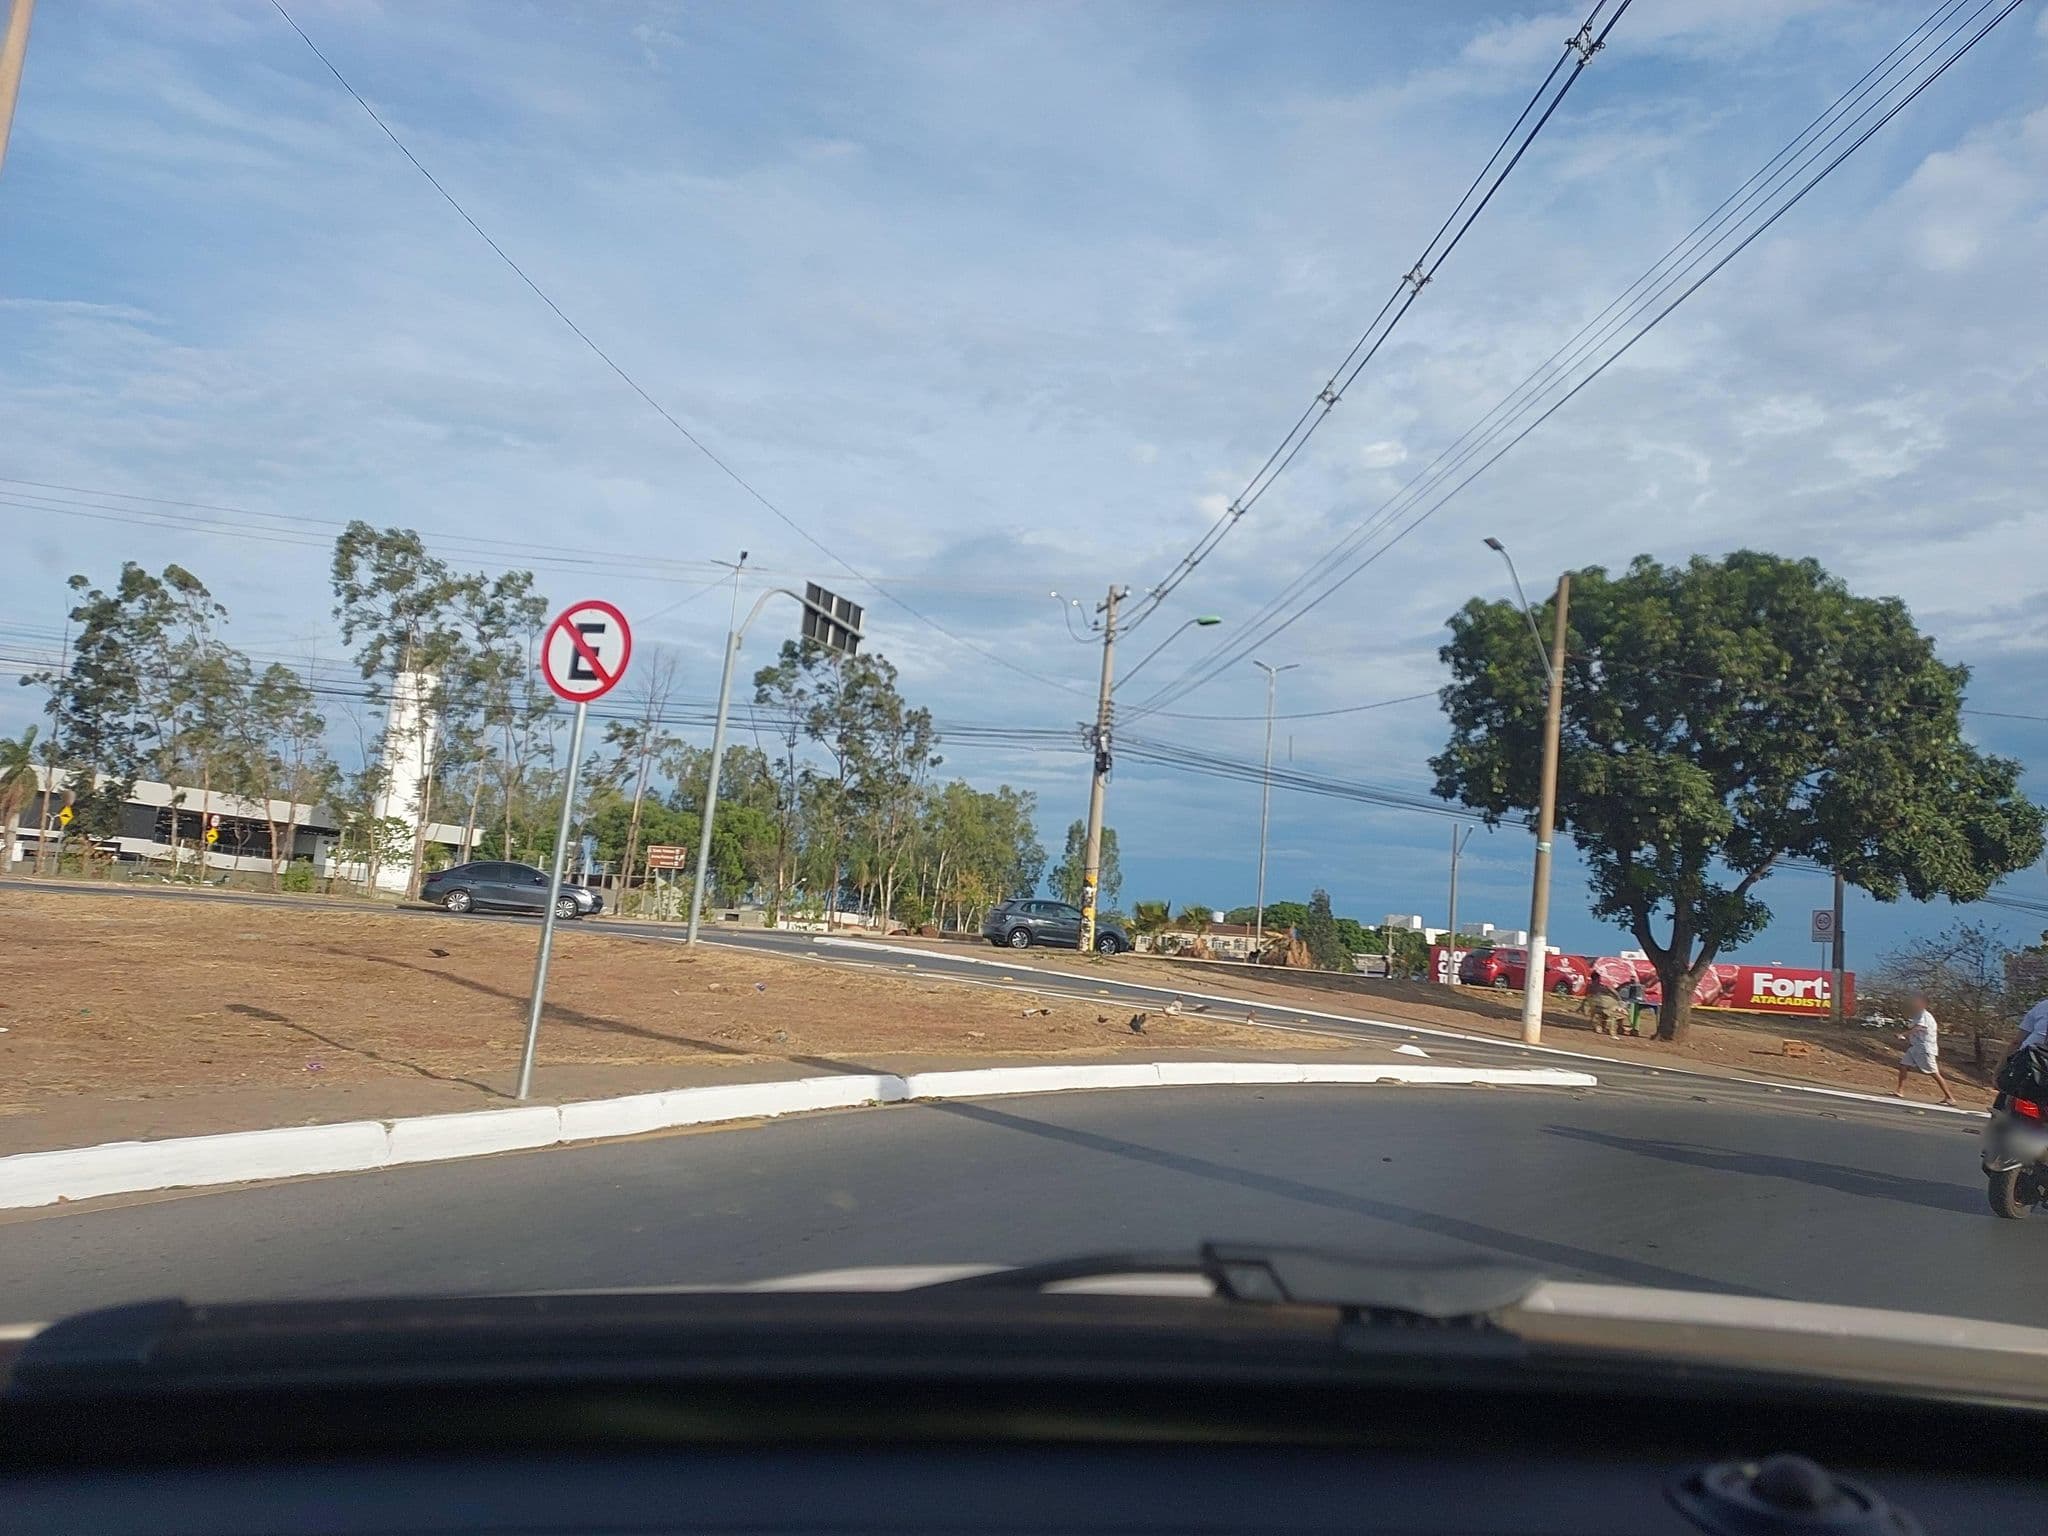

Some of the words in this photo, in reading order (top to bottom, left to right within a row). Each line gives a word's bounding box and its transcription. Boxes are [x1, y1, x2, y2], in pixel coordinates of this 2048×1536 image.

[568, 623, 606, 680] E
[1753, 972, 1831, 999] Fort
[1750, 995, 1831, 1008] ATACADISTA
